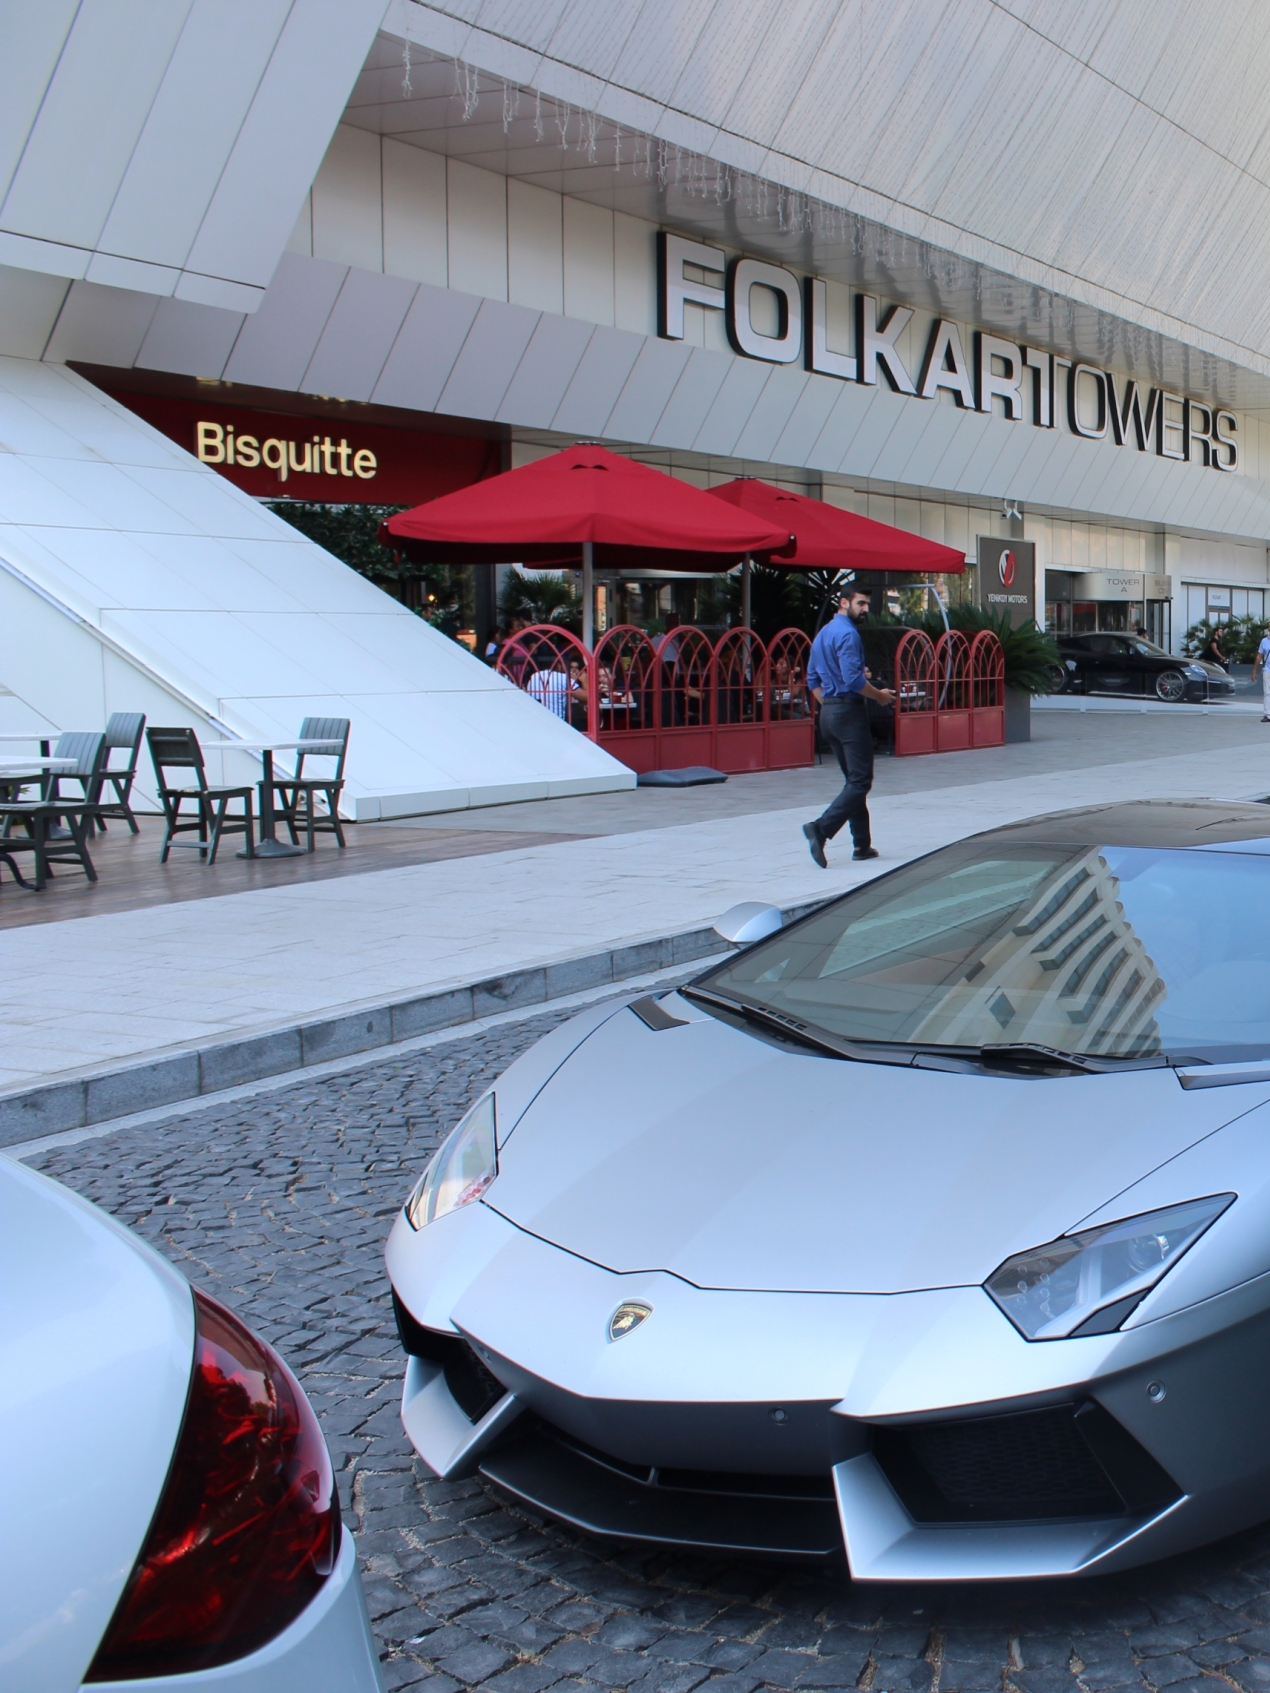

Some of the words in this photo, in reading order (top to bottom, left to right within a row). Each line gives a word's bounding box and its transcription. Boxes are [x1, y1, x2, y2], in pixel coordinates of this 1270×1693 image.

[657, 231, 1050, 428] FOLKART
[1050, 354, 1238, 472] TOWERS
[196, 421, 377, 482] Bisquitte
[1008, 595, 1028, 604] MOTORS
[1107, 578, 1140, 586] TOWER
